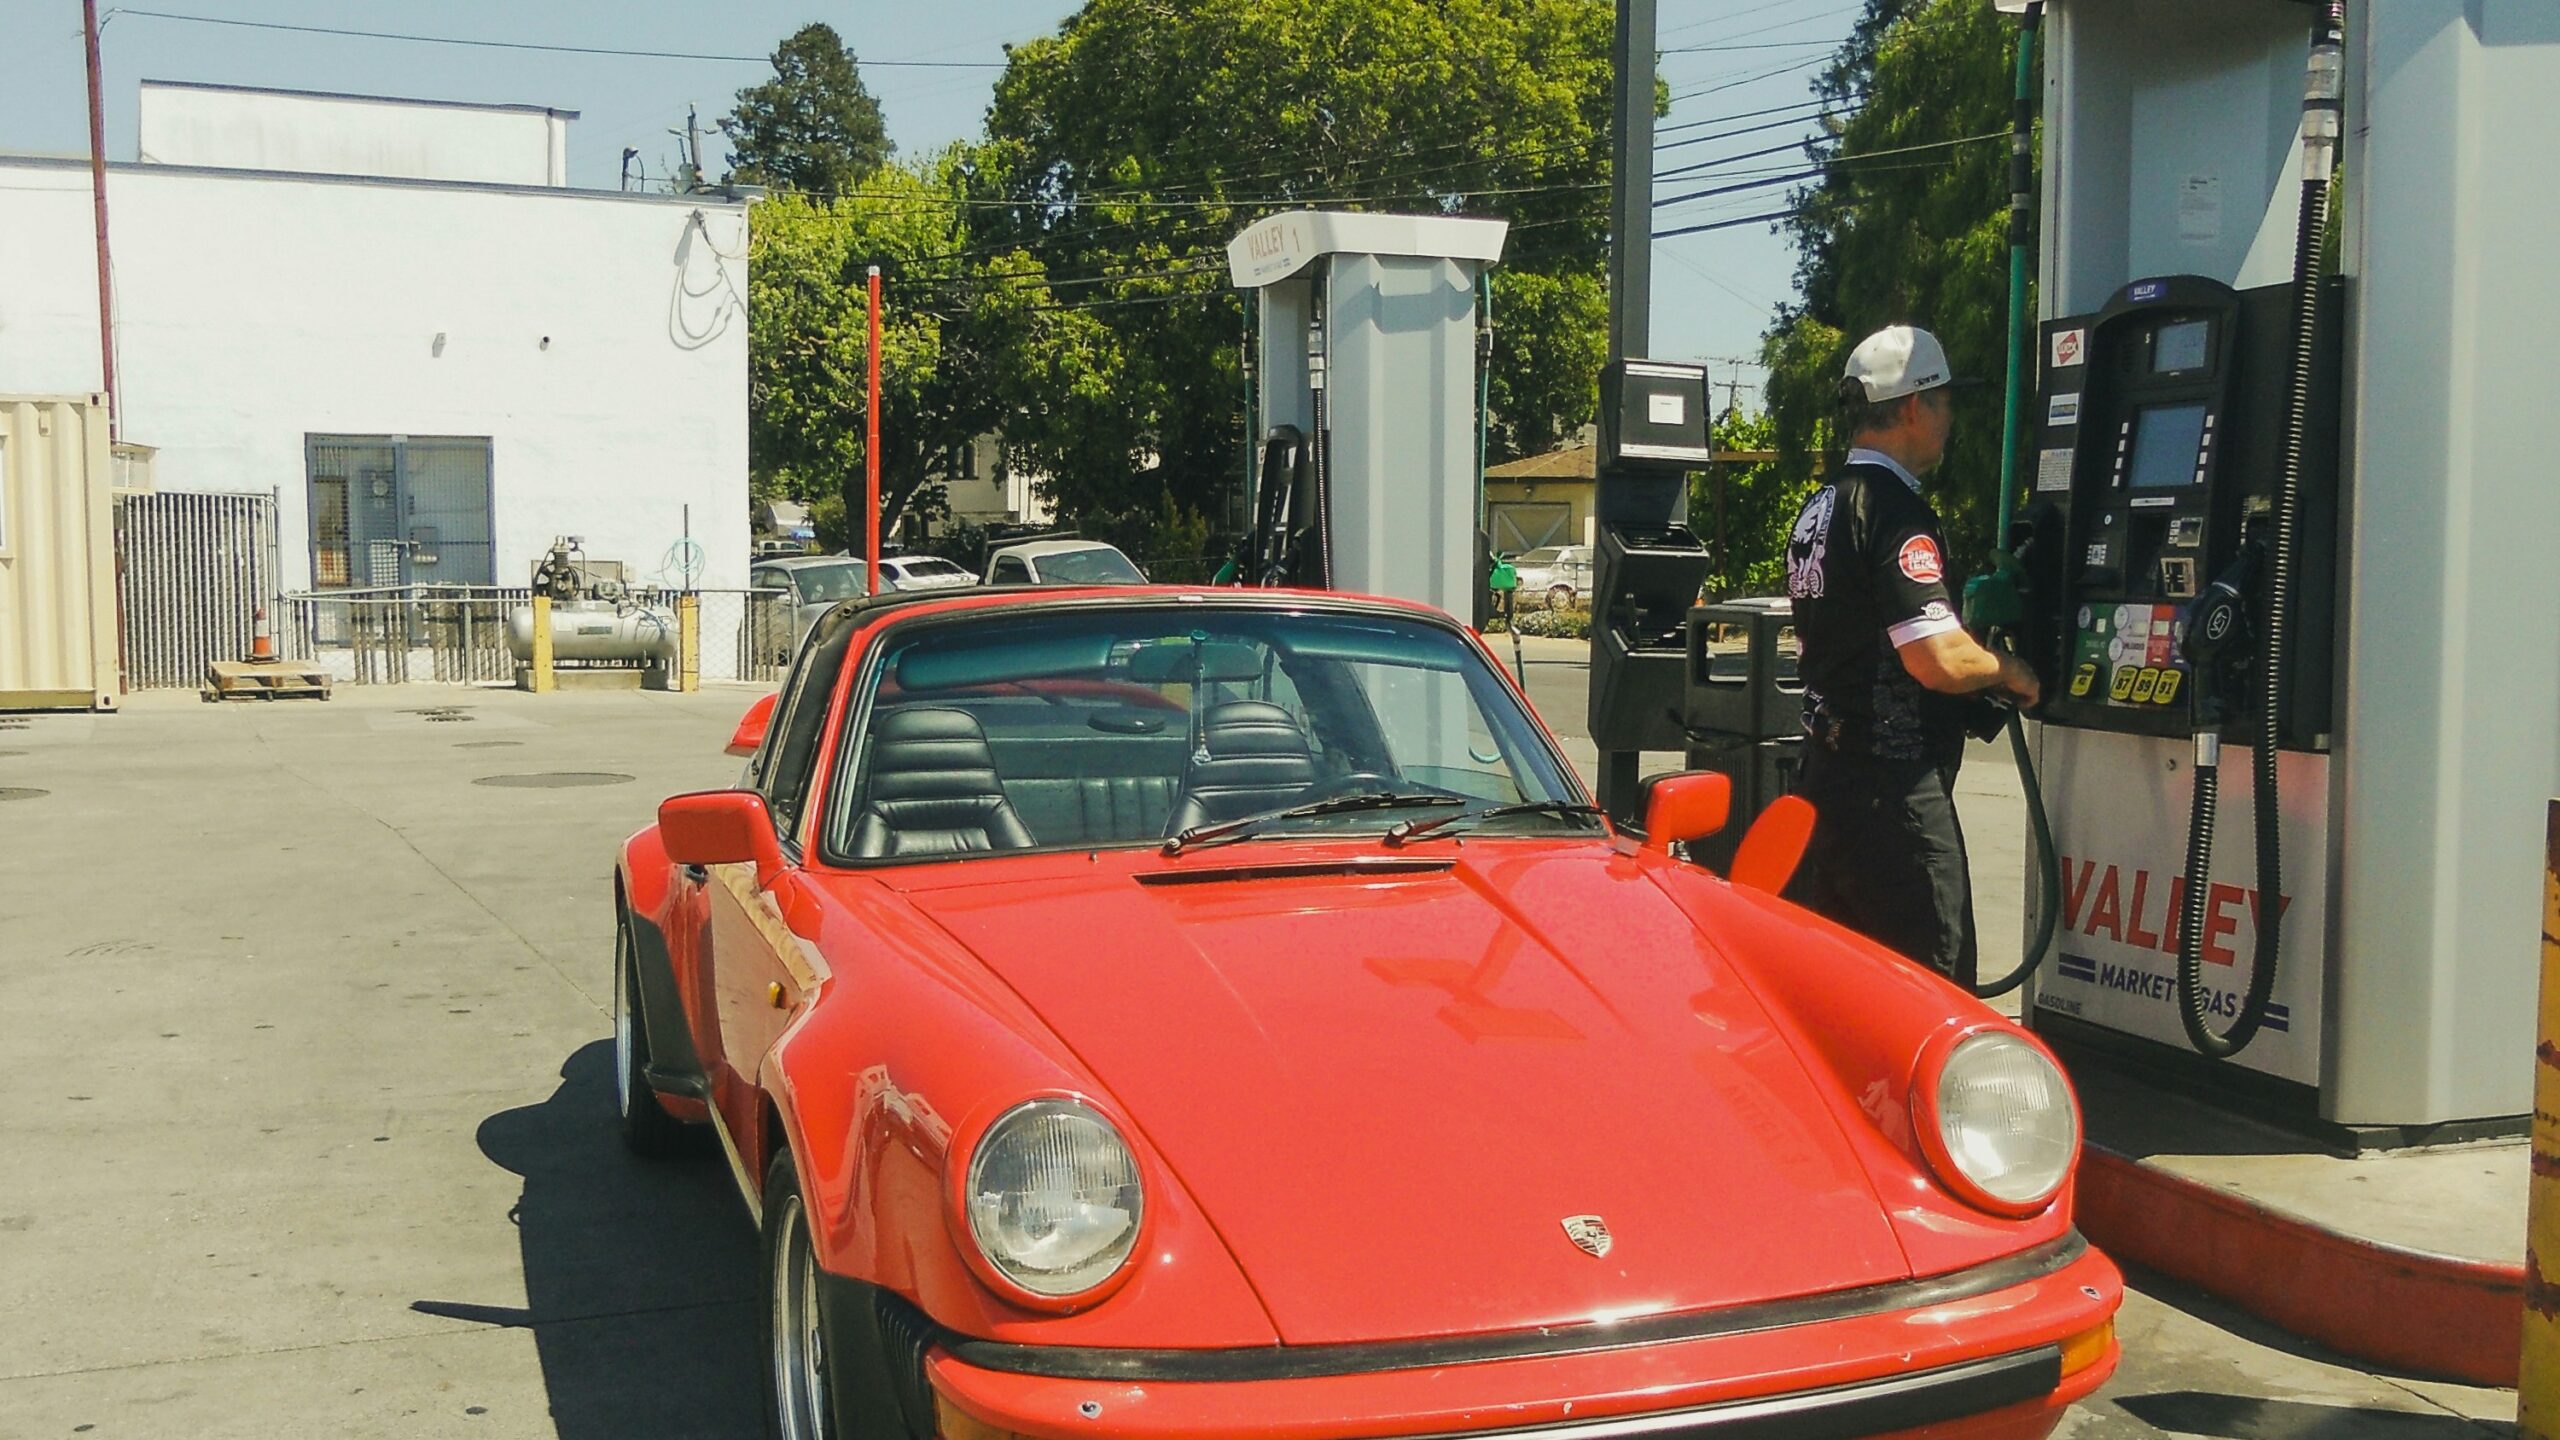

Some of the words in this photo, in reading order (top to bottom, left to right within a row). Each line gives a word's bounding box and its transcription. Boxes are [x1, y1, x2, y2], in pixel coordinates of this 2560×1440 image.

[1247, 224, 1284, 260] VALLEY
[2115, 678, 2130, 691] 87
[2159, 682, 2173, 695] 91
[2100, 963, 2177, 1002] MARKET
[2198, 986, 2237, 1018] GAS
[2037, 993, 2082, 1015] GASOLINE
